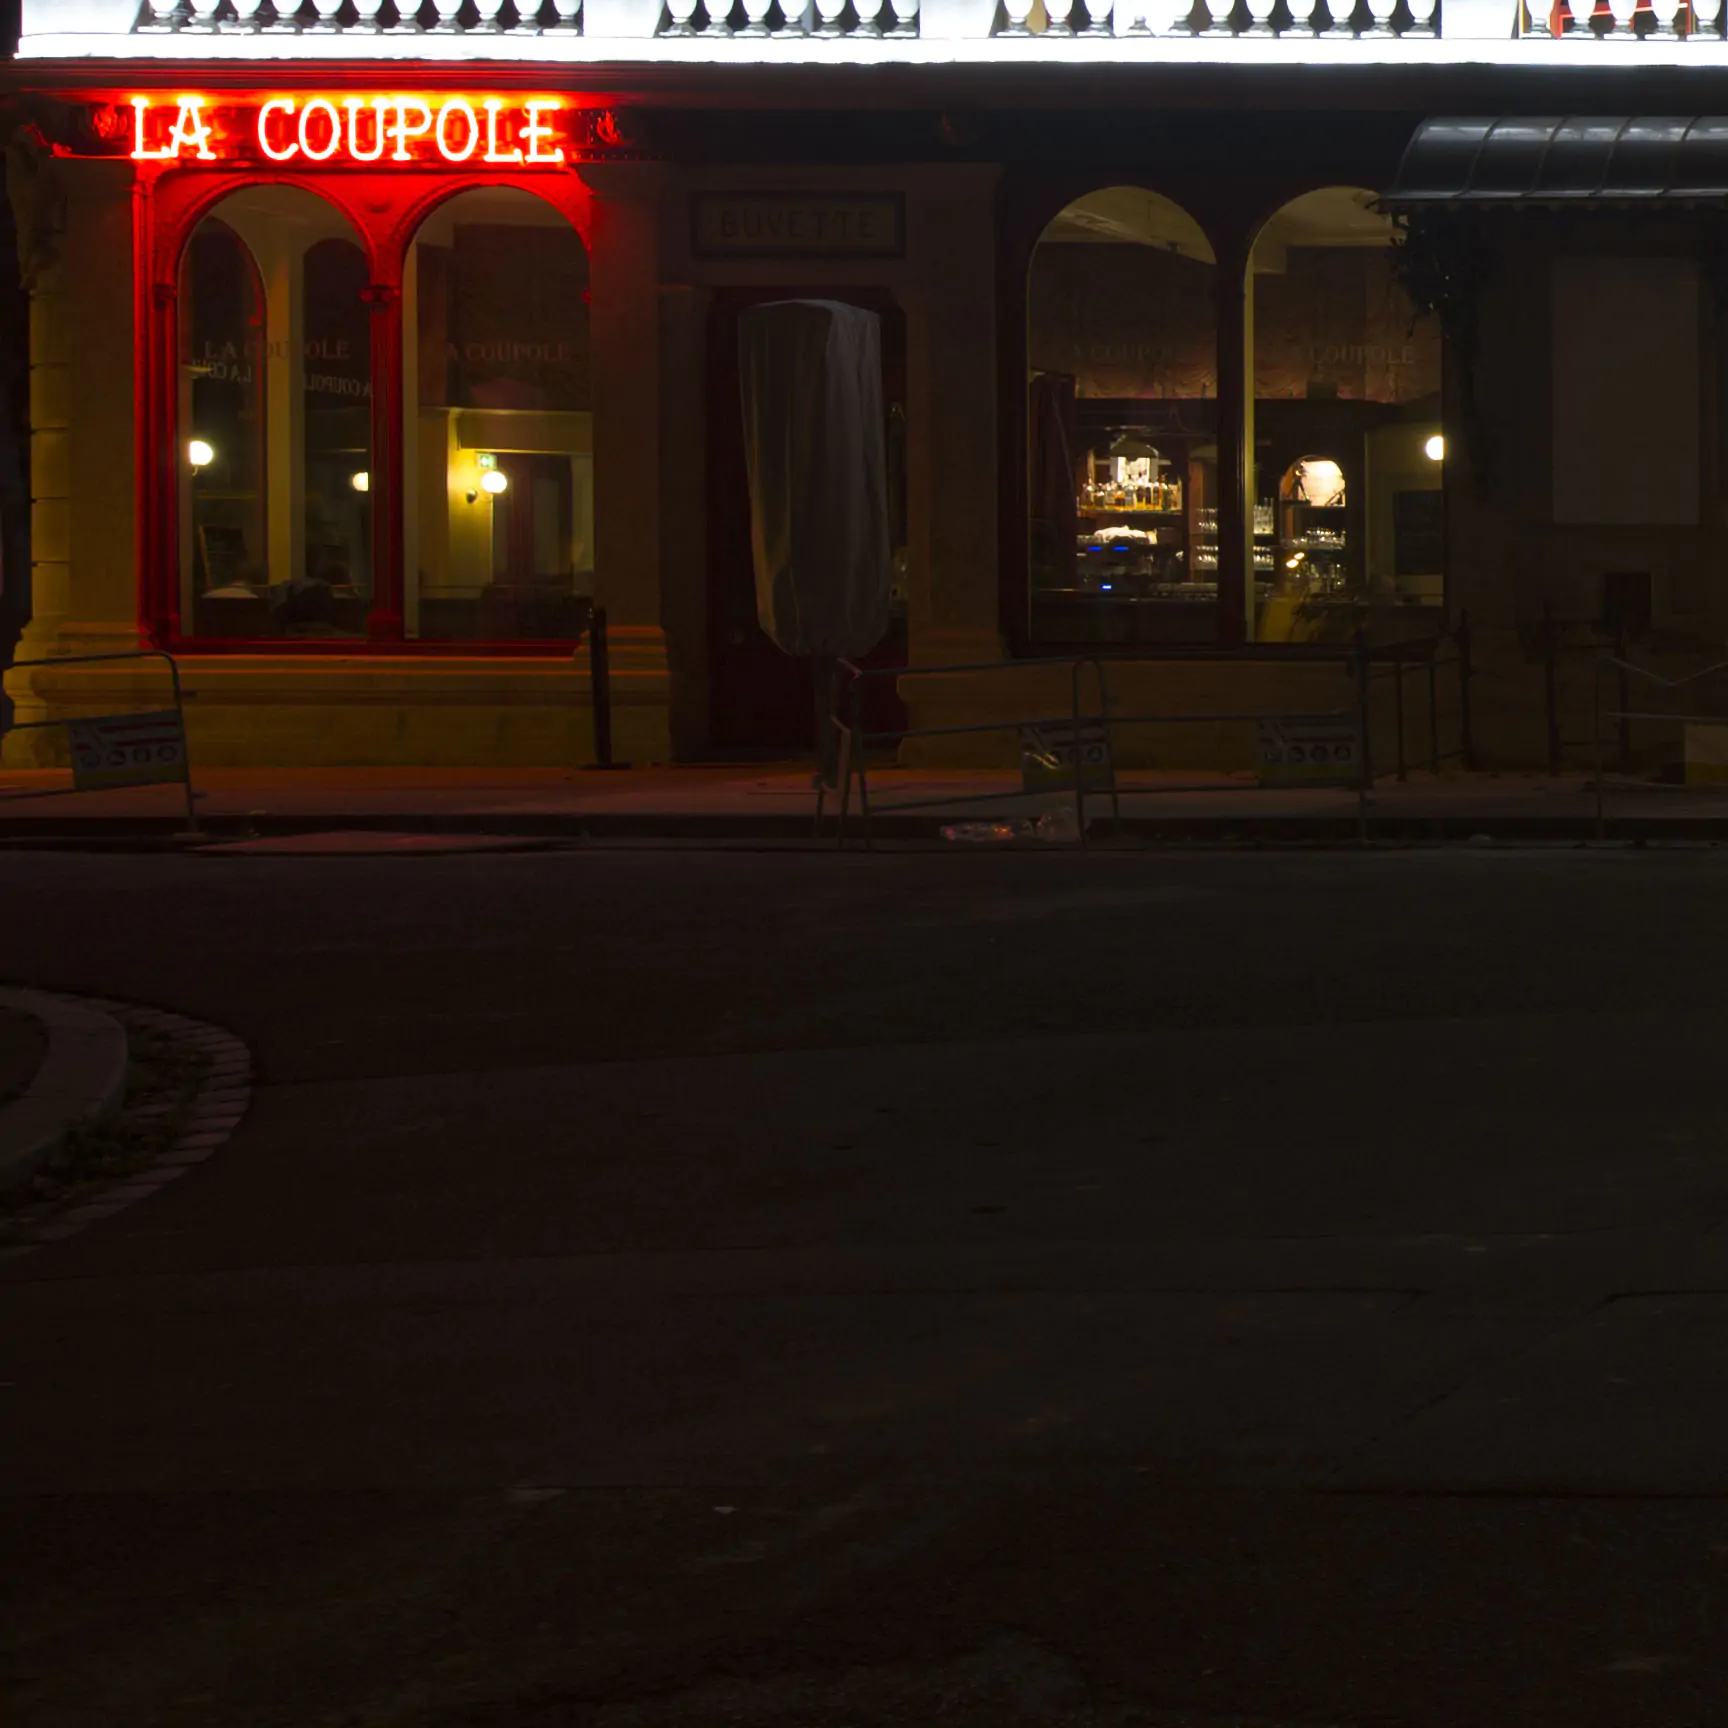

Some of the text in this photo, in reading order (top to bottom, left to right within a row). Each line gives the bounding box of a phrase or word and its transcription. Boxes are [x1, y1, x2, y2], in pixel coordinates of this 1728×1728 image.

[130, 97, 564, 163] LA COUPOLE
[720, 208, 876, 239] BUVETTE
